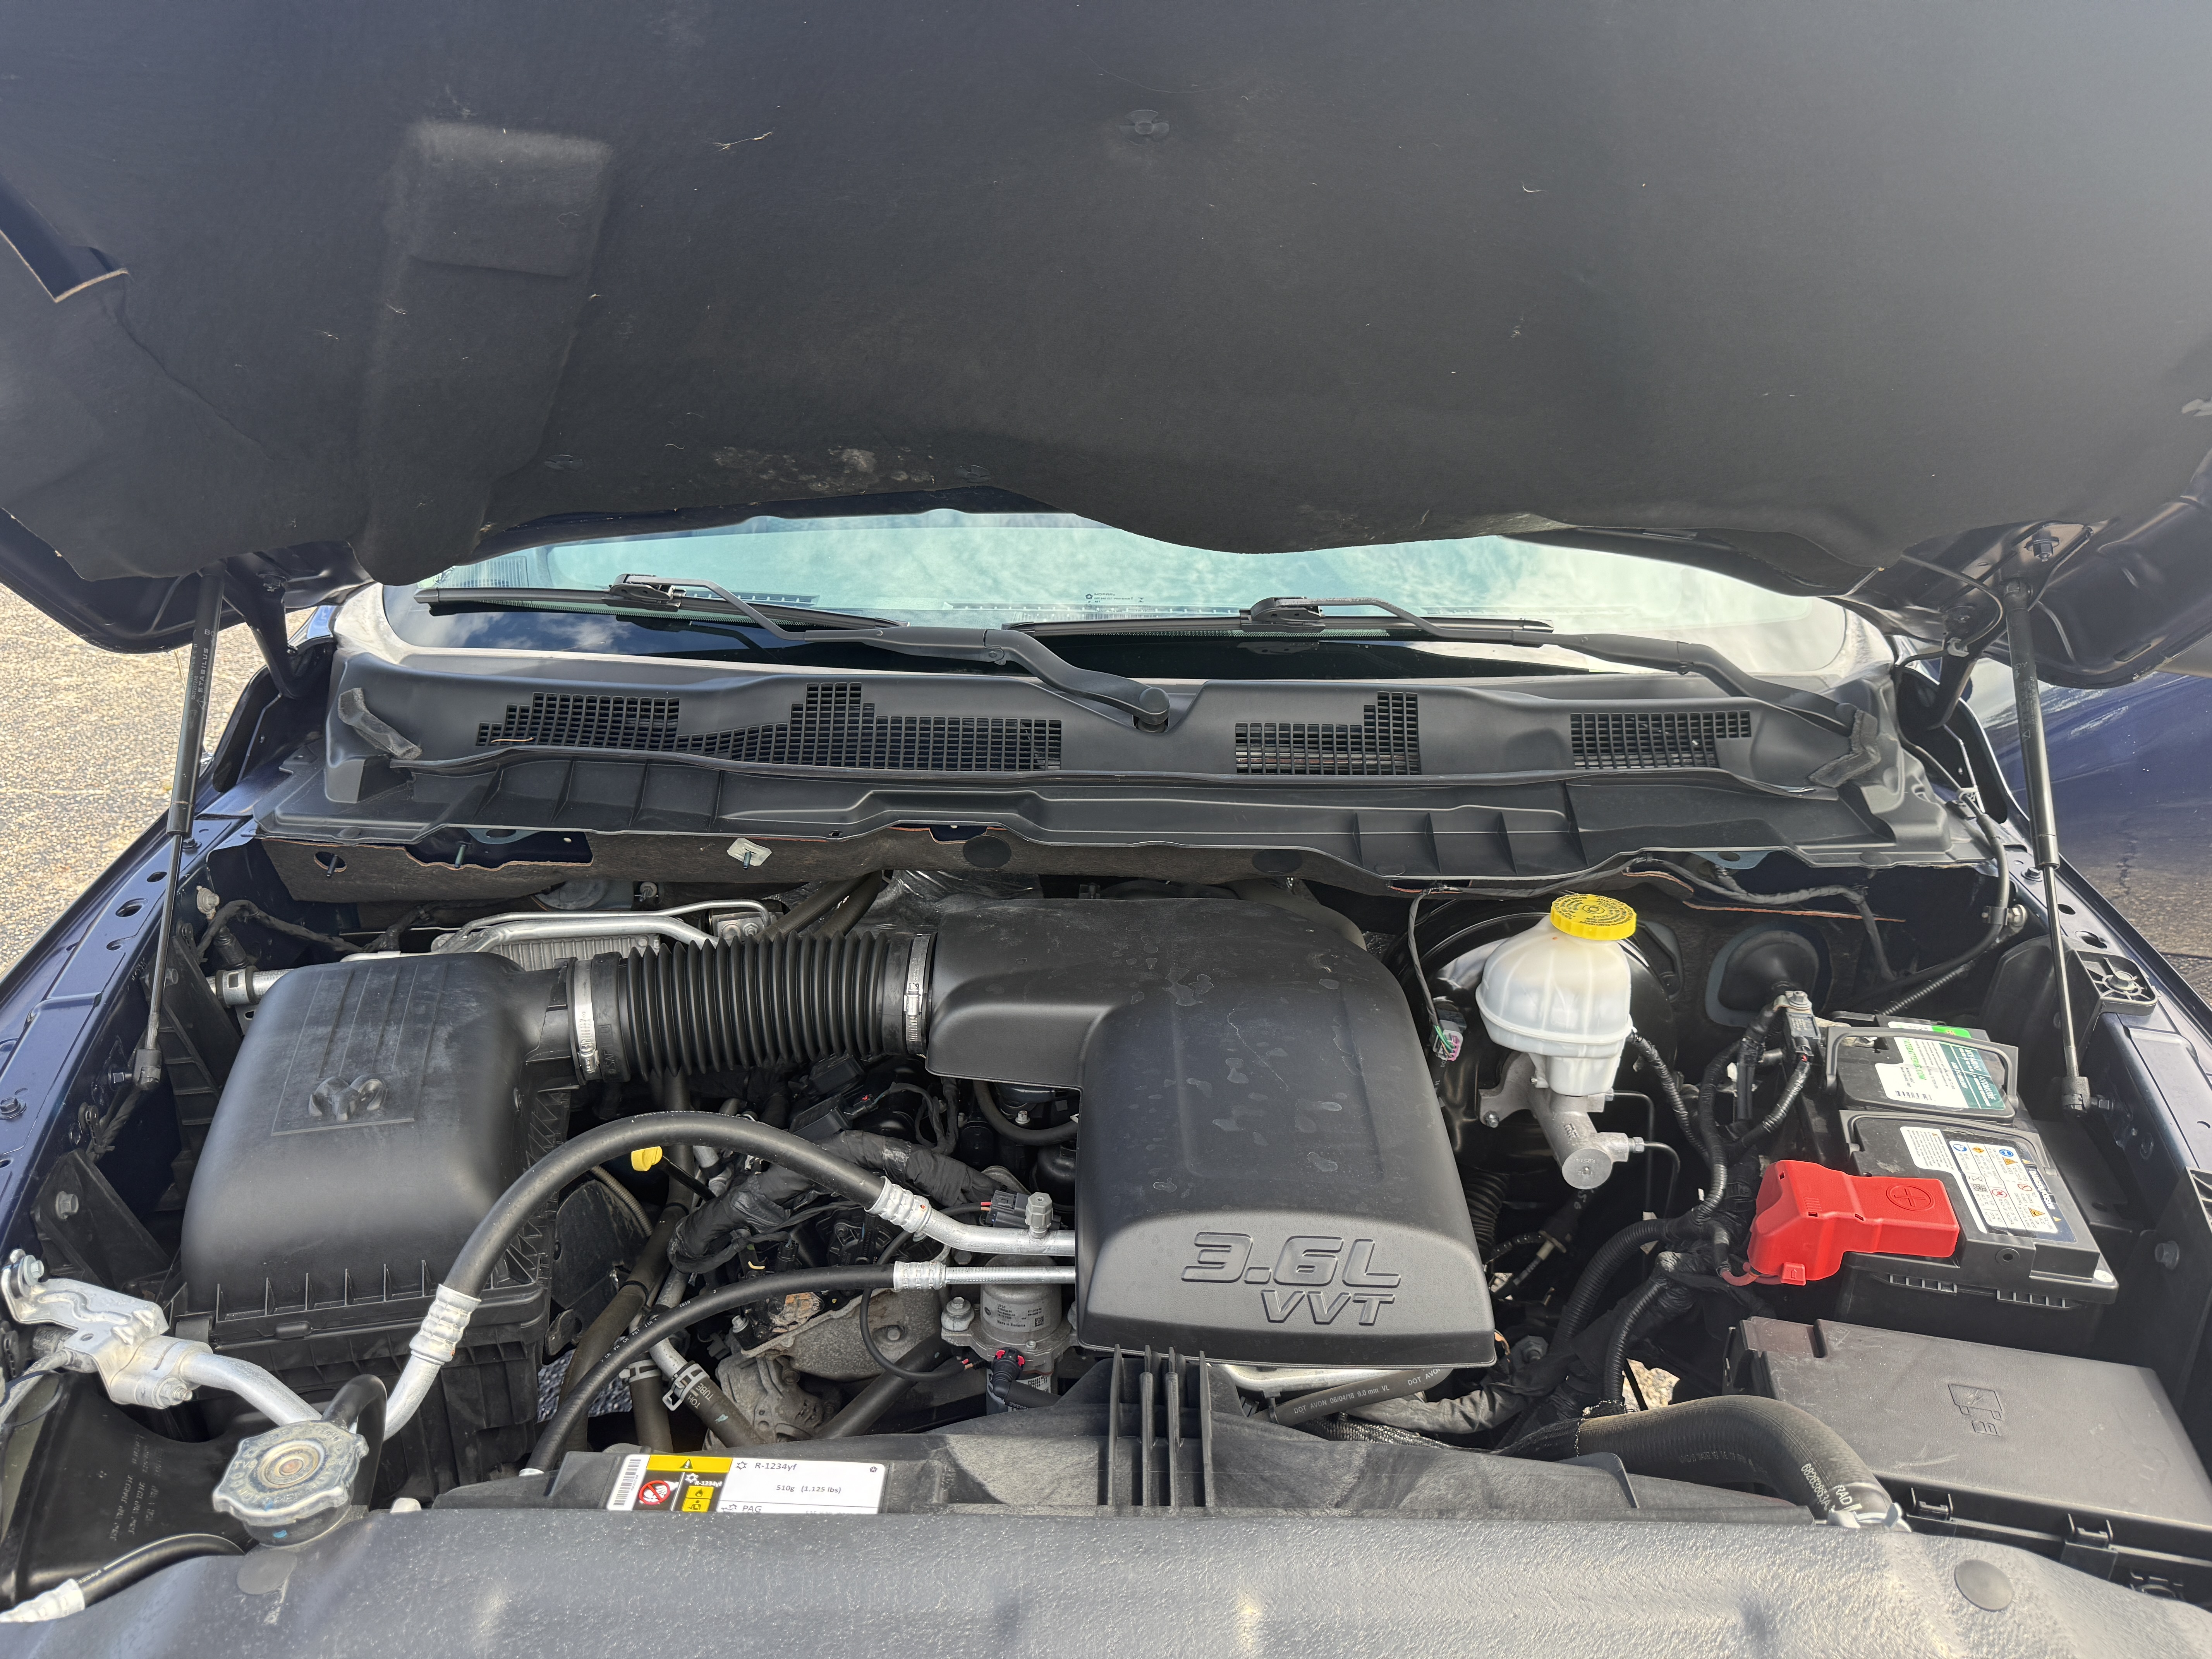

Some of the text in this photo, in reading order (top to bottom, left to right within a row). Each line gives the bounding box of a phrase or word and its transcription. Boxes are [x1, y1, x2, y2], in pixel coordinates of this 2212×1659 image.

[198, 647, 209, 693] STABILUS
[1181, 1231, 1401, 1288] 3.6L
[1261, 1289, 1395, 1326] VVT
[696, 1382, 714, 1401] TUBE
[1294, 1405, 1307, 1414] DOT
[1310, 1399, 1327, 1409] AVON
[1407, 1376, 1421, 1386] DOT
[1425, 1368, 1441, 1379] AVO
[755, 1462, 797, 1471] R-1234yf
[742, 1505, 762, 1513] PAG
[1835, 1484, 1853, 1505] RAD
